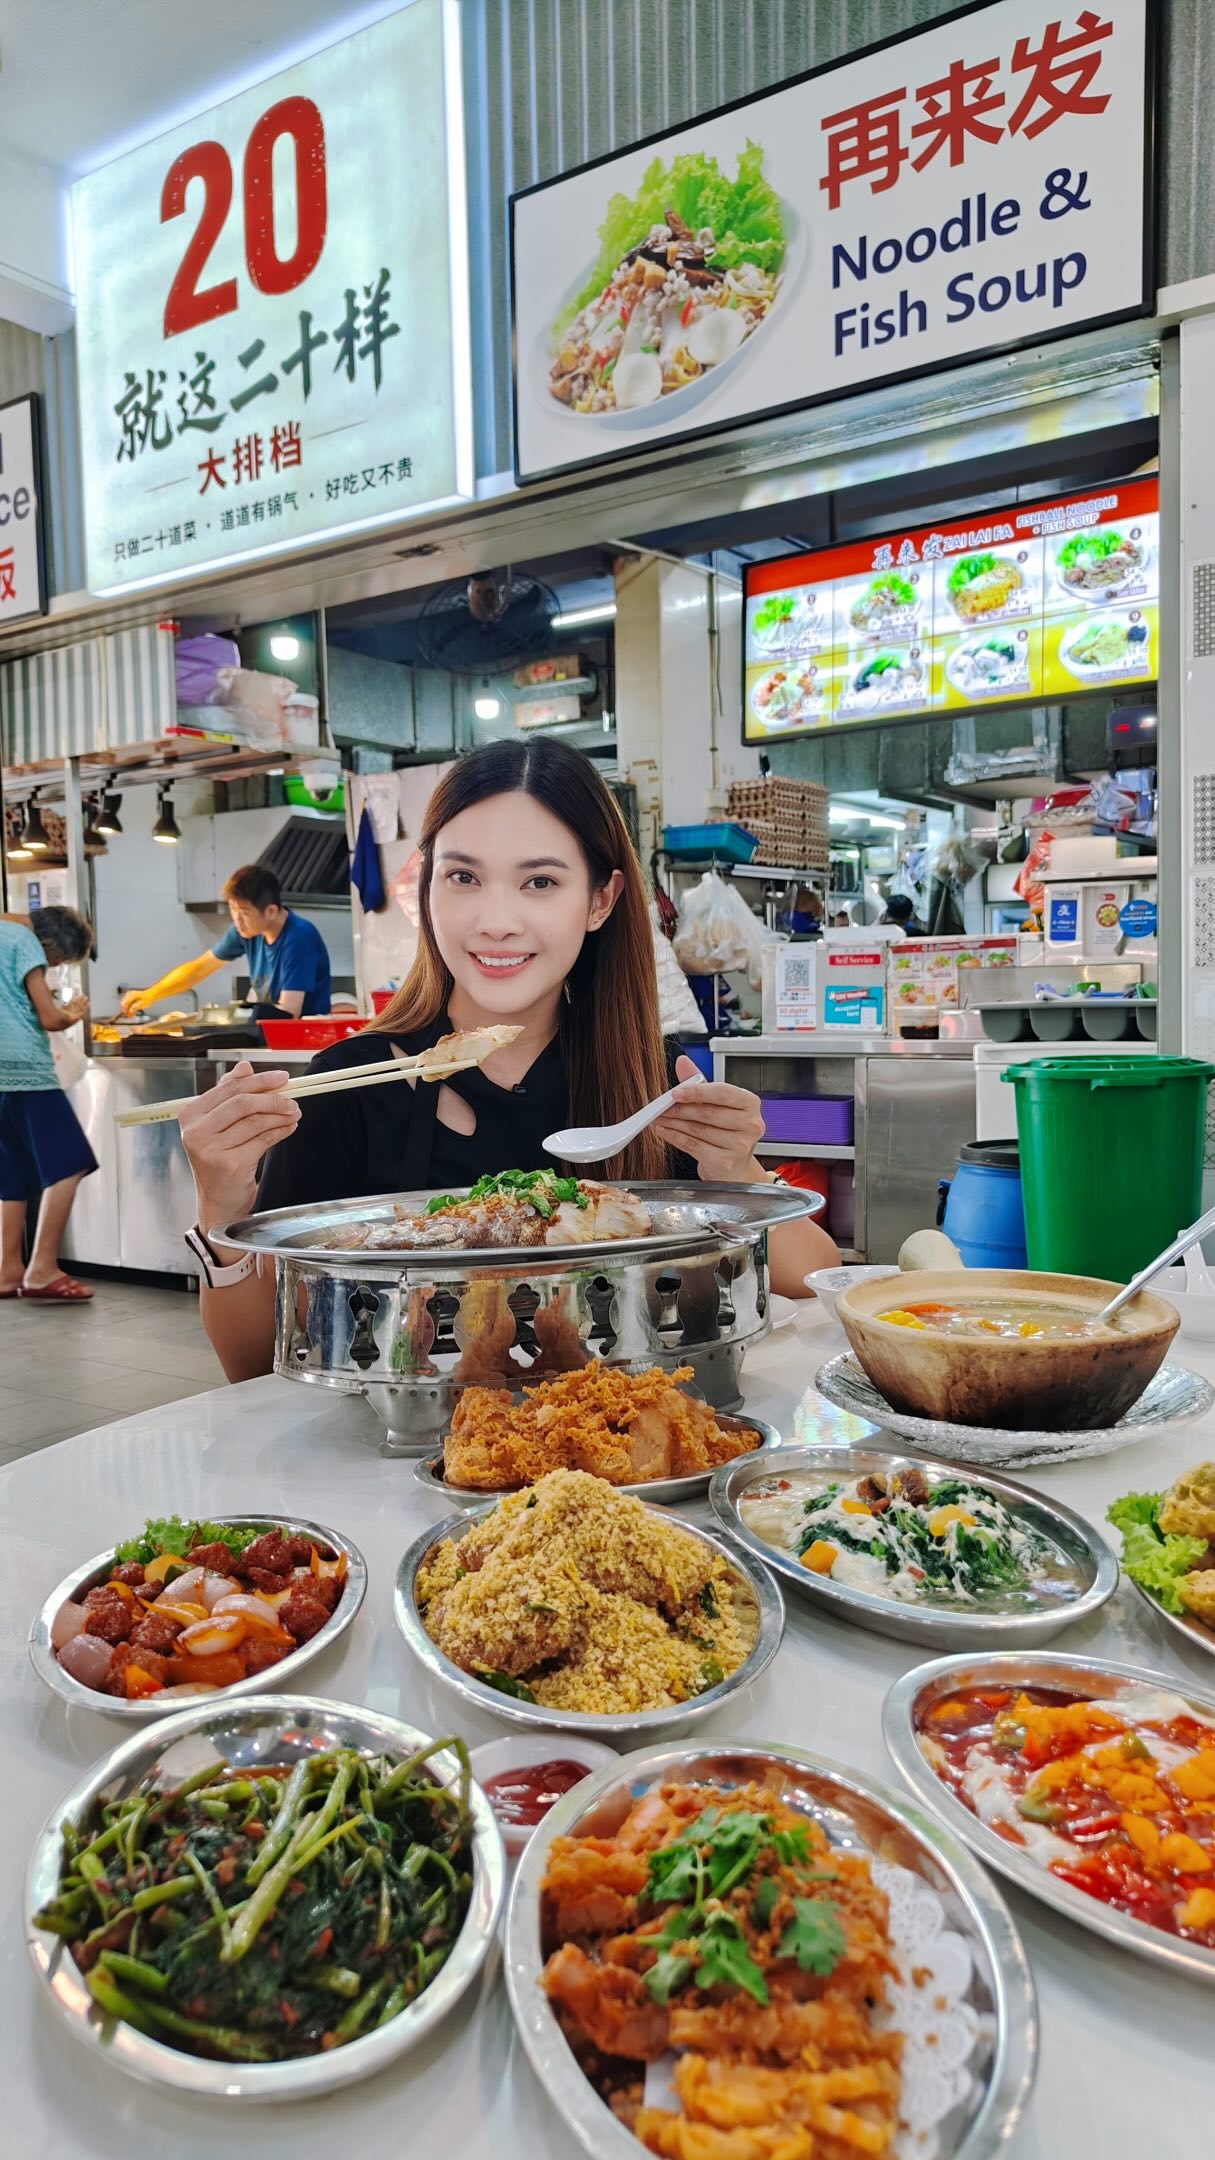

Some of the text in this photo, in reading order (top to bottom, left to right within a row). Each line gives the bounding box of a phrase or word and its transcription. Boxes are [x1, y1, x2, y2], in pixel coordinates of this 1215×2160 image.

[819, 11, 1113, 210] 再来发
[160, 95, 327, 340] 20
[832, 167, 1092, 289] Noodle &
[834, 250, 1087, 356] Fish Soup
[114, 268, 400, 462] 就这二十样
[113, 456, 414, 562] 只做二十道菜 道道有锅气 好吃又不贵
[197, 421, 302, 495] 大排档
[944, 524, 1013, 551] ZAI LAI FA
[1017, 495, 1117, 528] FISHBALL NOODLE
[834, 955, 875, 965] Self Service
